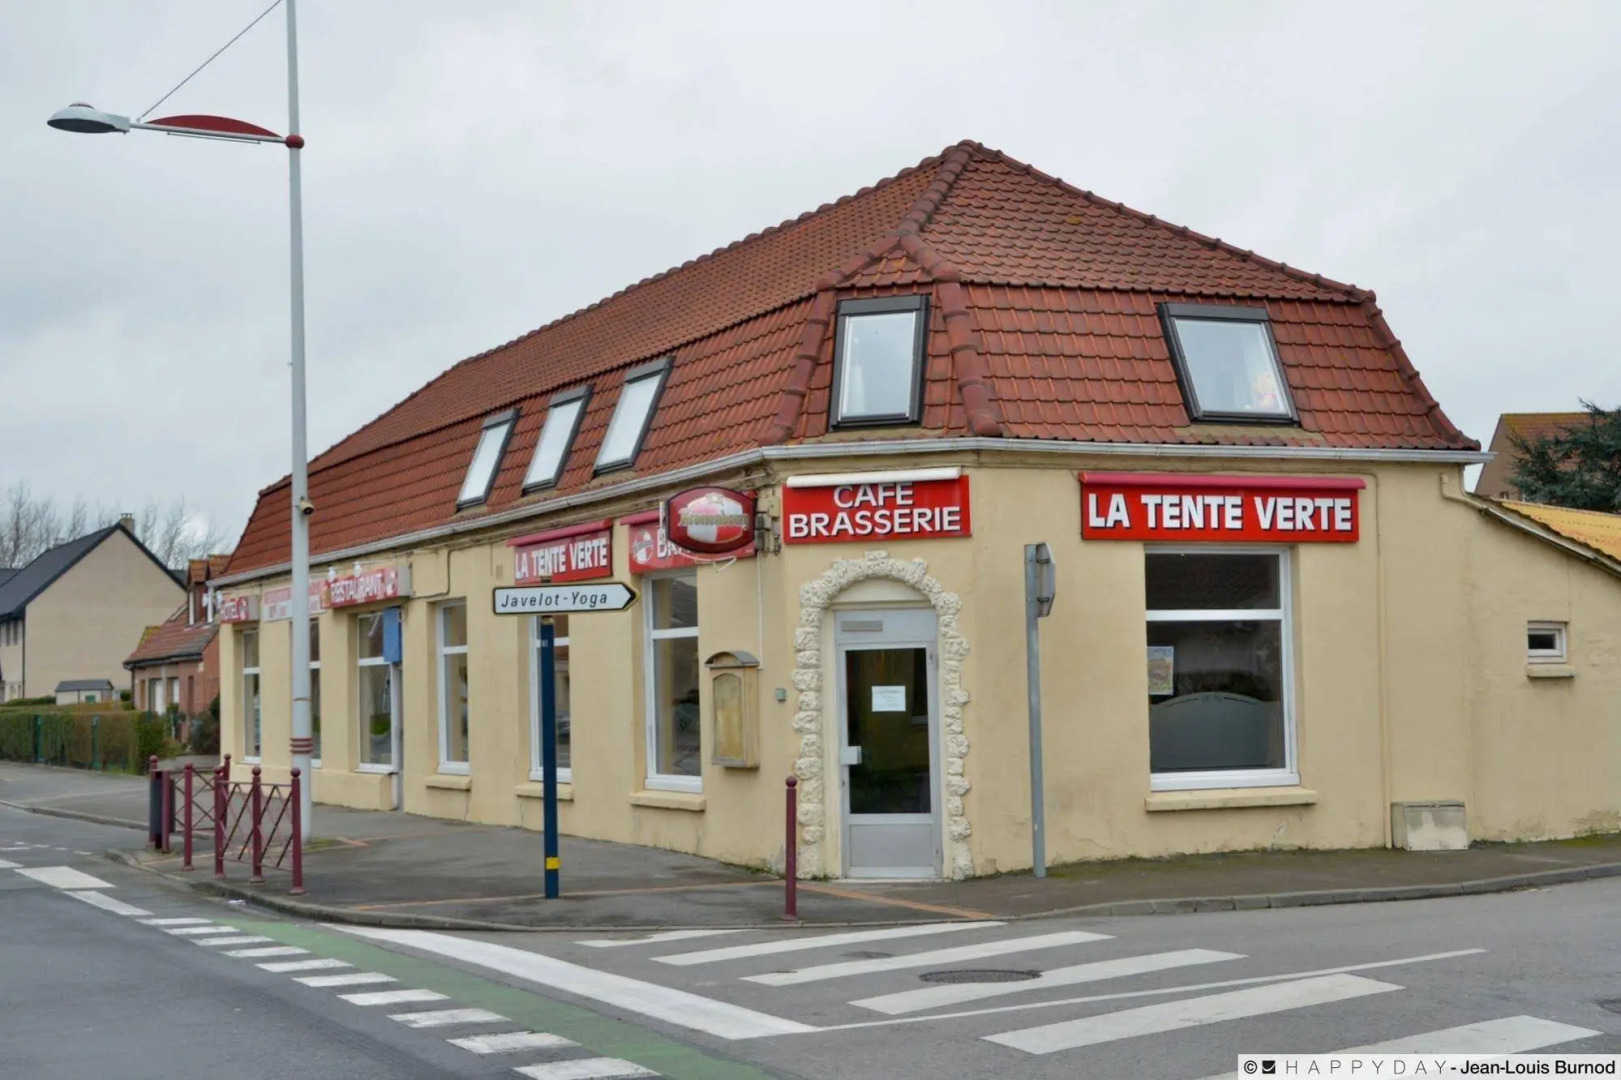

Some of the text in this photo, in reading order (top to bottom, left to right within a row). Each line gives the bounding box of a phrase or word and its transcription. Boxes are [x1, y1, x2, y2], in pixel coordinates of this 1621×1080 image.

[833, 481, 914, 509] CAFE
[788, 506, 961, 538] BRASSERIE
[1088, 493, 1353, 531] LA TENTE VERTE
[515, 537, 608, 580] LA TENTE VERTE
[330, 572, 384, 604] RESTAURANT
[501, 591, 608, 609] Javelot-Yoga
